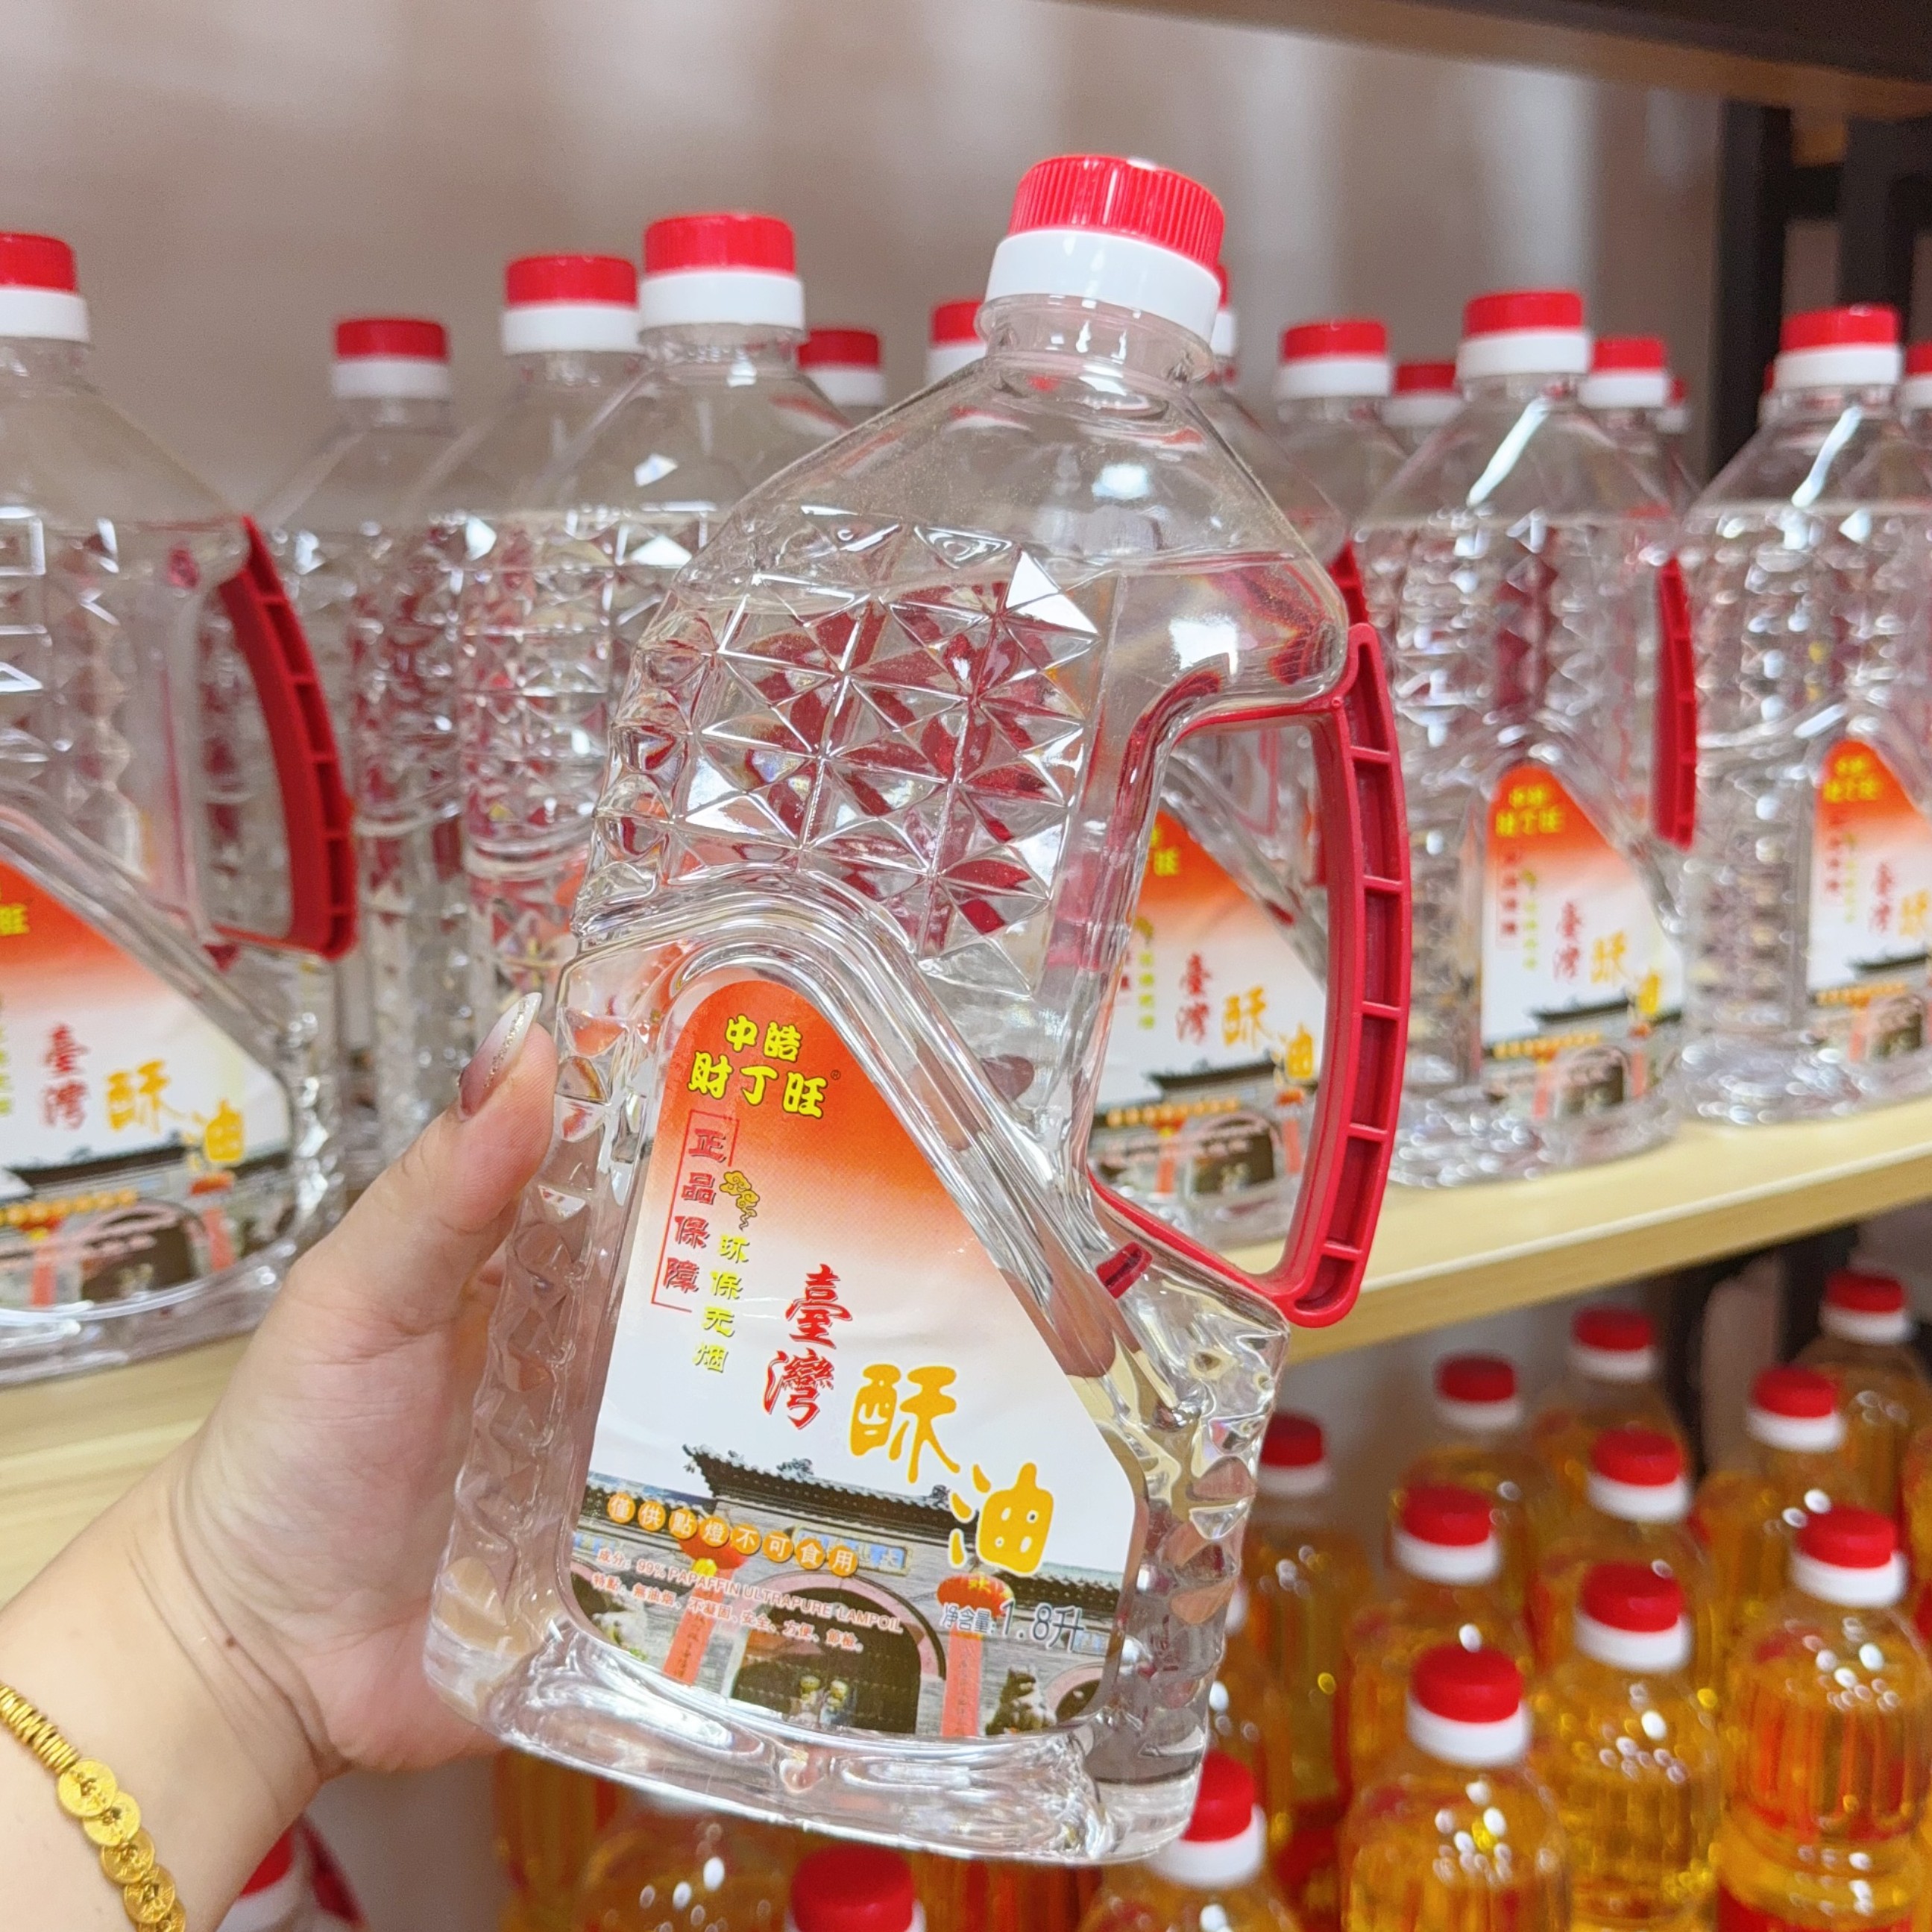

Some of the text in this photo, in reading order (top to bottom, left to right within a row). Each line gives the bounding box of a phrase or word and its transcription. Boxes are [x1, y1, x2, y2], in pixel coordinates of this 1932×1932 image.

[687, 1049, 828, 1118] 財丁旺
[662, 1126, 727, 1295] 正品保障
[692, 1234, 750, 1374] 环保无烟
[762, 1263, 852, 1430] 臺灣
[849, 1362, 1054, 1576] 酥油
[743, 1584, 834, 1619] ULTRAPURE
[836, 1607, 904, 1634] LAMPOIL
